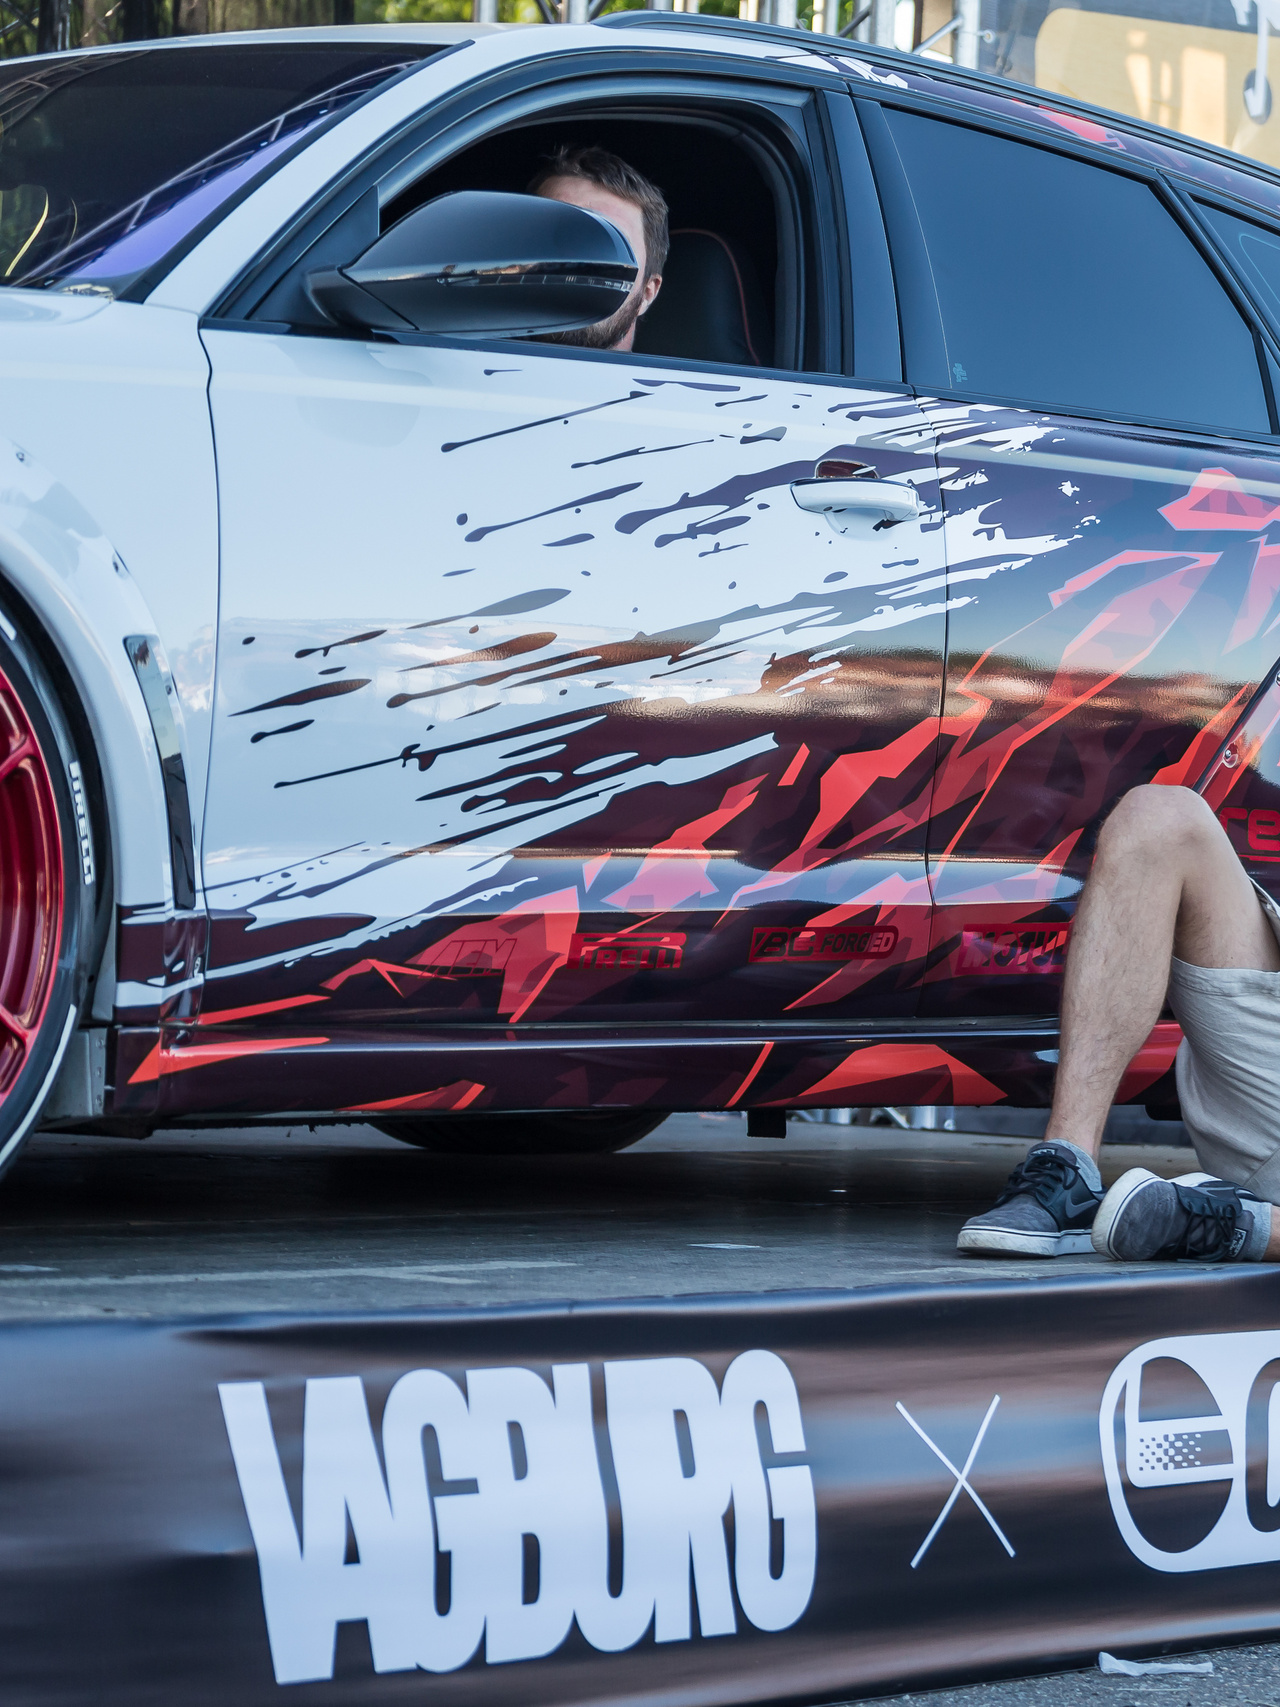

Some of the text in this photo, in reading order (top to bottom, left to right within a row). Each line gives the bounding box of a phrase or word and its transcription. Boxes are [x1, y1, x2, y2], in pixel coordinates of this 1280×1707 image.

[566, 932, 687, 969] PIRELLI
[753, 930, 894, 957] BC FORGED
[217, 1349, 817, 1684] VAGBURG
